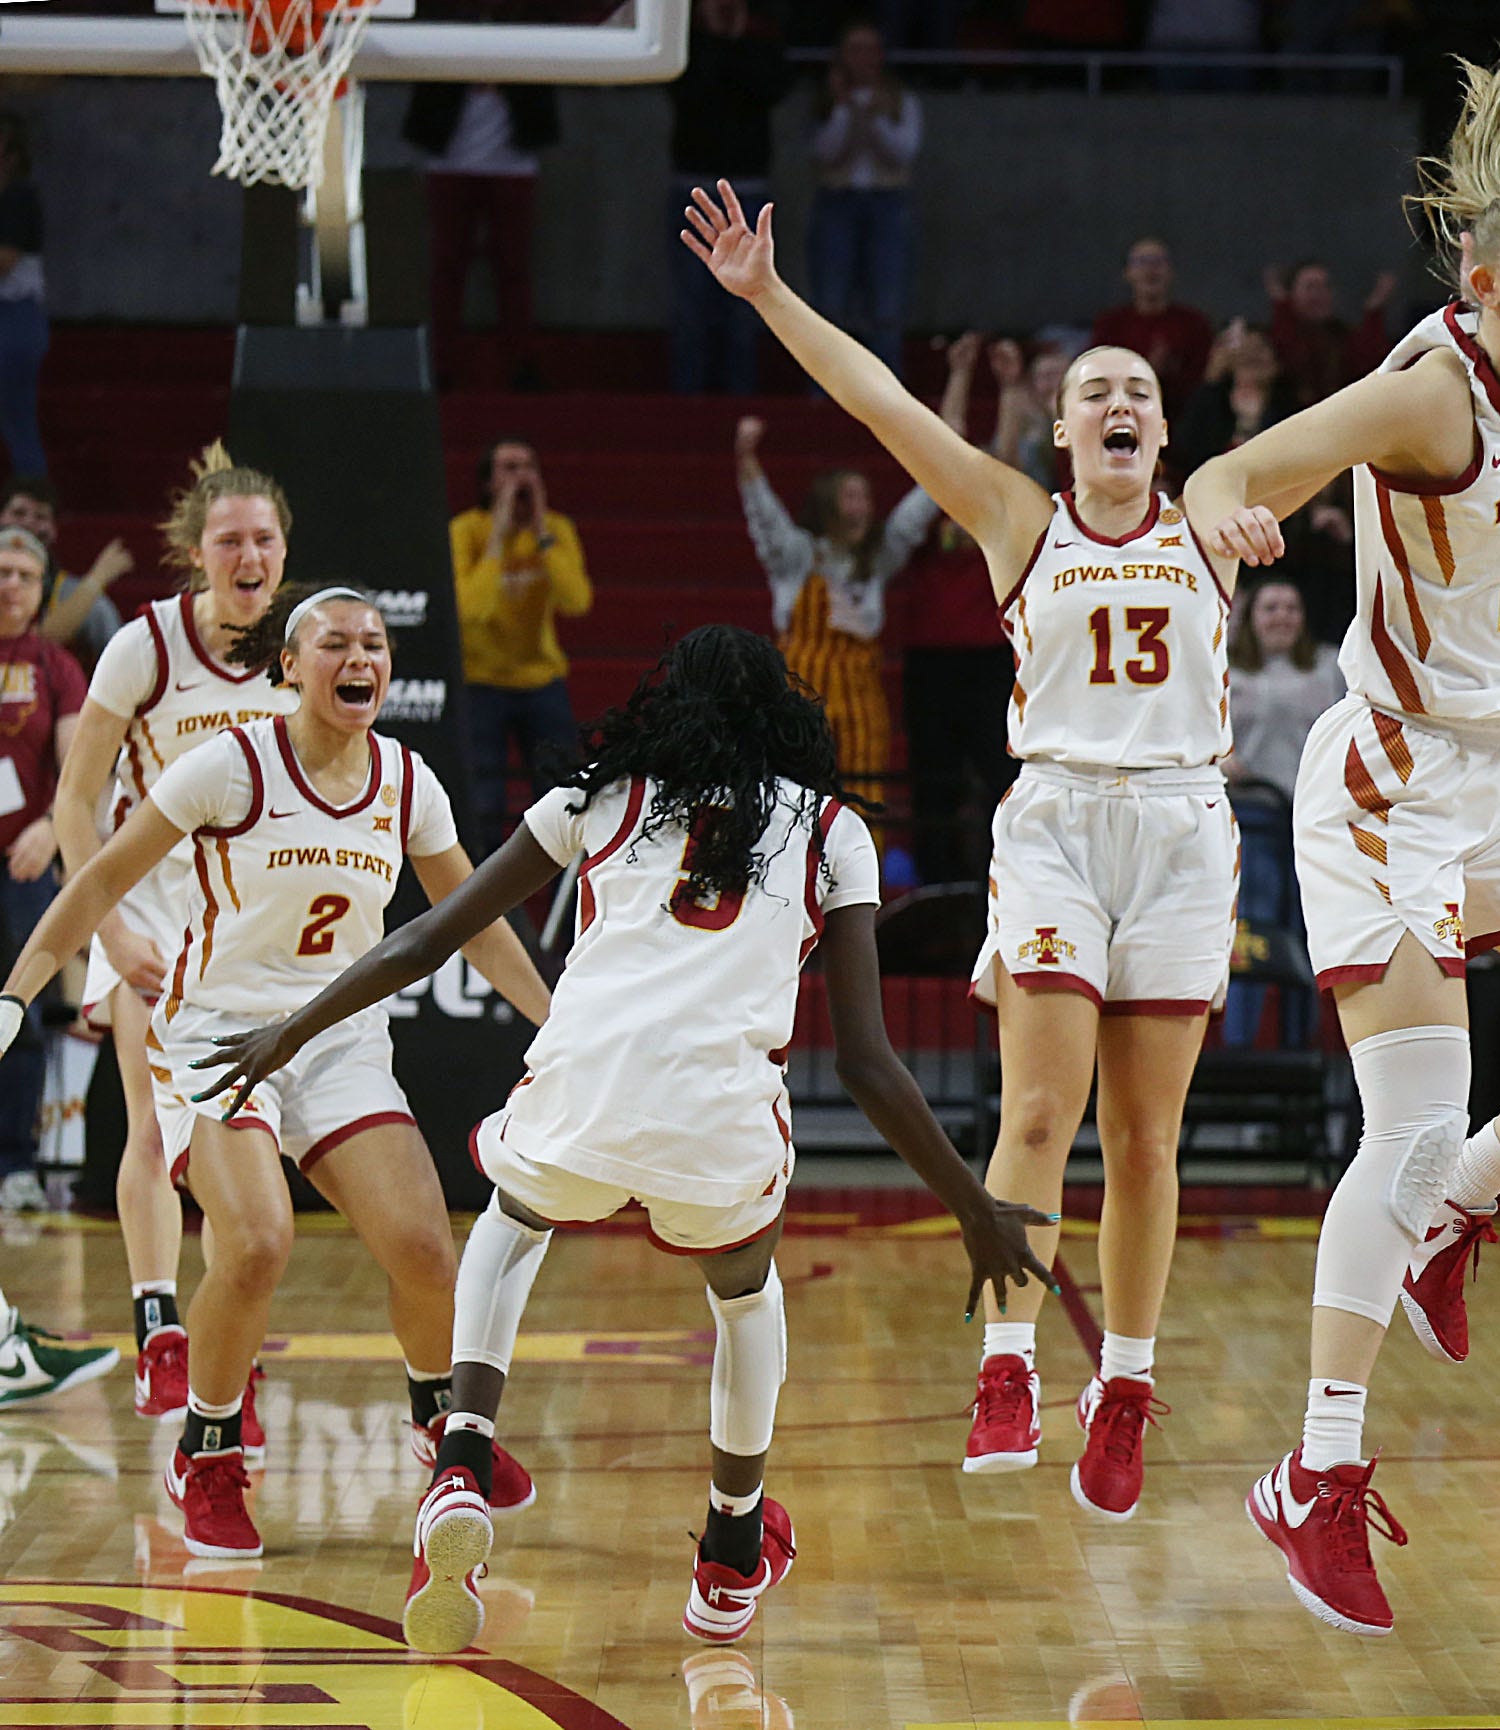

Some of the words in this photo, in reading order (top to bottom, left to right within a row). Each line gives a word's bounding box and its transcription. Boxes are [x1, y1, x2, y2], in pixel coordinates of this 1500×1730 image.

[1052, 564, 1118, 594] IOWA
[1121, 563, 1199, 595] STATE
[1088, 604, 1170, 687] 13
[176, 710, 233, 737] IOWA
[266, 847, 331, 870] IOWA
[335, 848, 394, 883] STATE
[295, 892, 351, 957] 2
[1016, 937, 1077, 961] STATE
